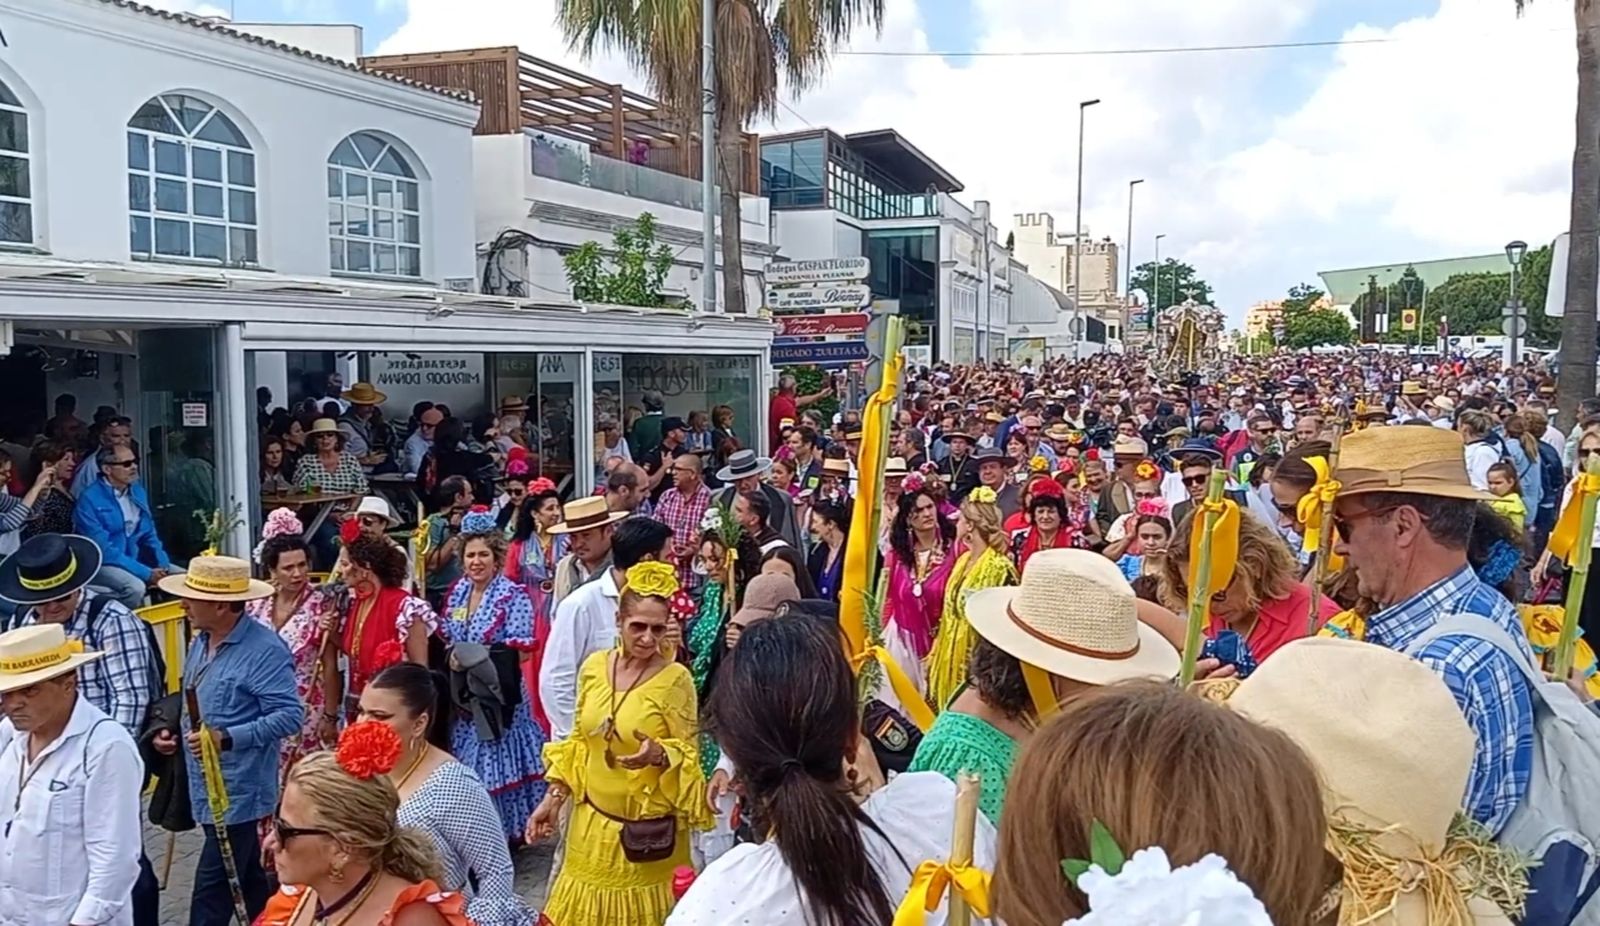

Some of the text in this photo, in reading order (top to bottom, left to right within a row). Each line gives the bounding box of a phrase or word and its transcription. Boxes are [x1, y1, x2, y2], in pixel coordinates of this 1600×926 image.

[798, 260, 828, 271] GASPAR
[829, 259, 865, 269] FLORIDO
[815, 346, 851, 357] ZULETA
[12, 653, 62, 669] BARRAMEDA
